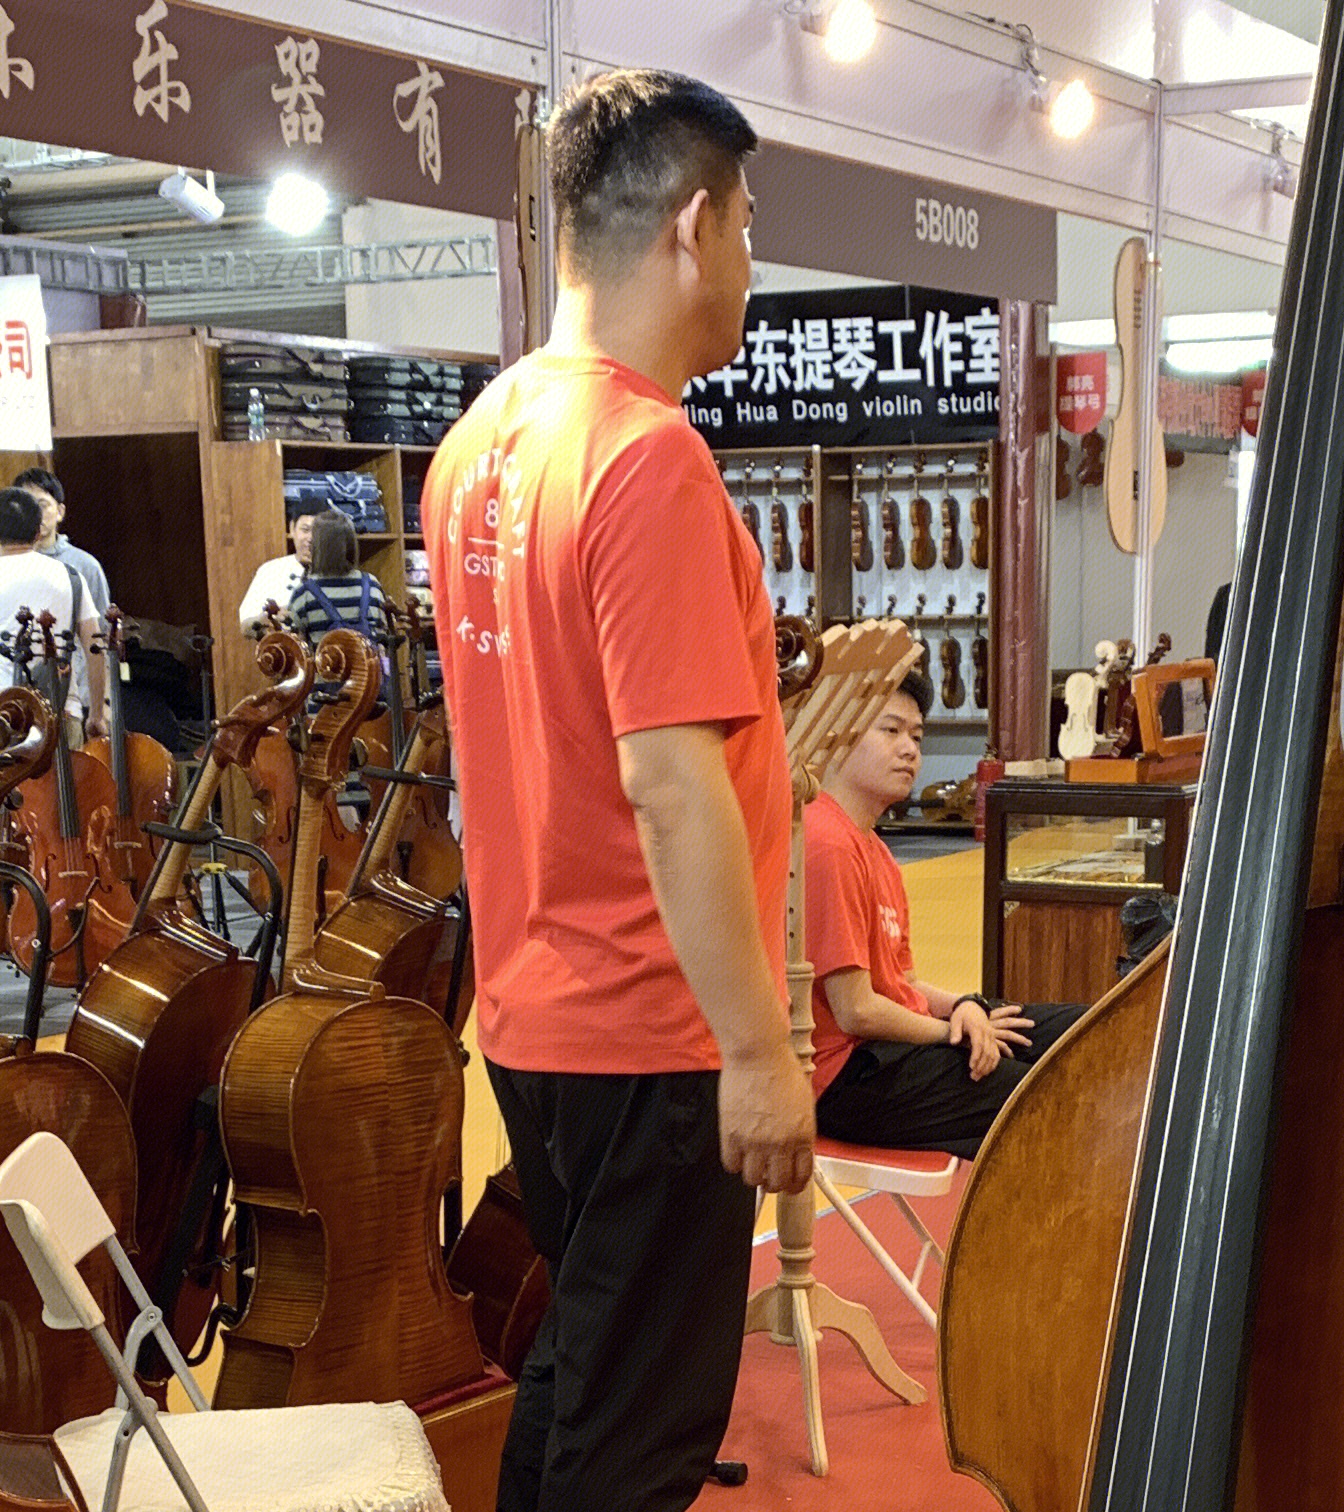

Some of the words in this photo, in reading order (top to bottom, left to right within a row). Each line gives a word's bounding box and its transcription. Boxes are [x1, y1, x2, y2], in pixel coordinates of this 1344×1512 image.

[915, 197, 980, 251] 5B008
[681, 307, 1000, 398] 东提琴工作室
[736, 401, 779, 423] Hua
[791, 399, 849, 423] Dong
[862, 394, 923, 418] violin
